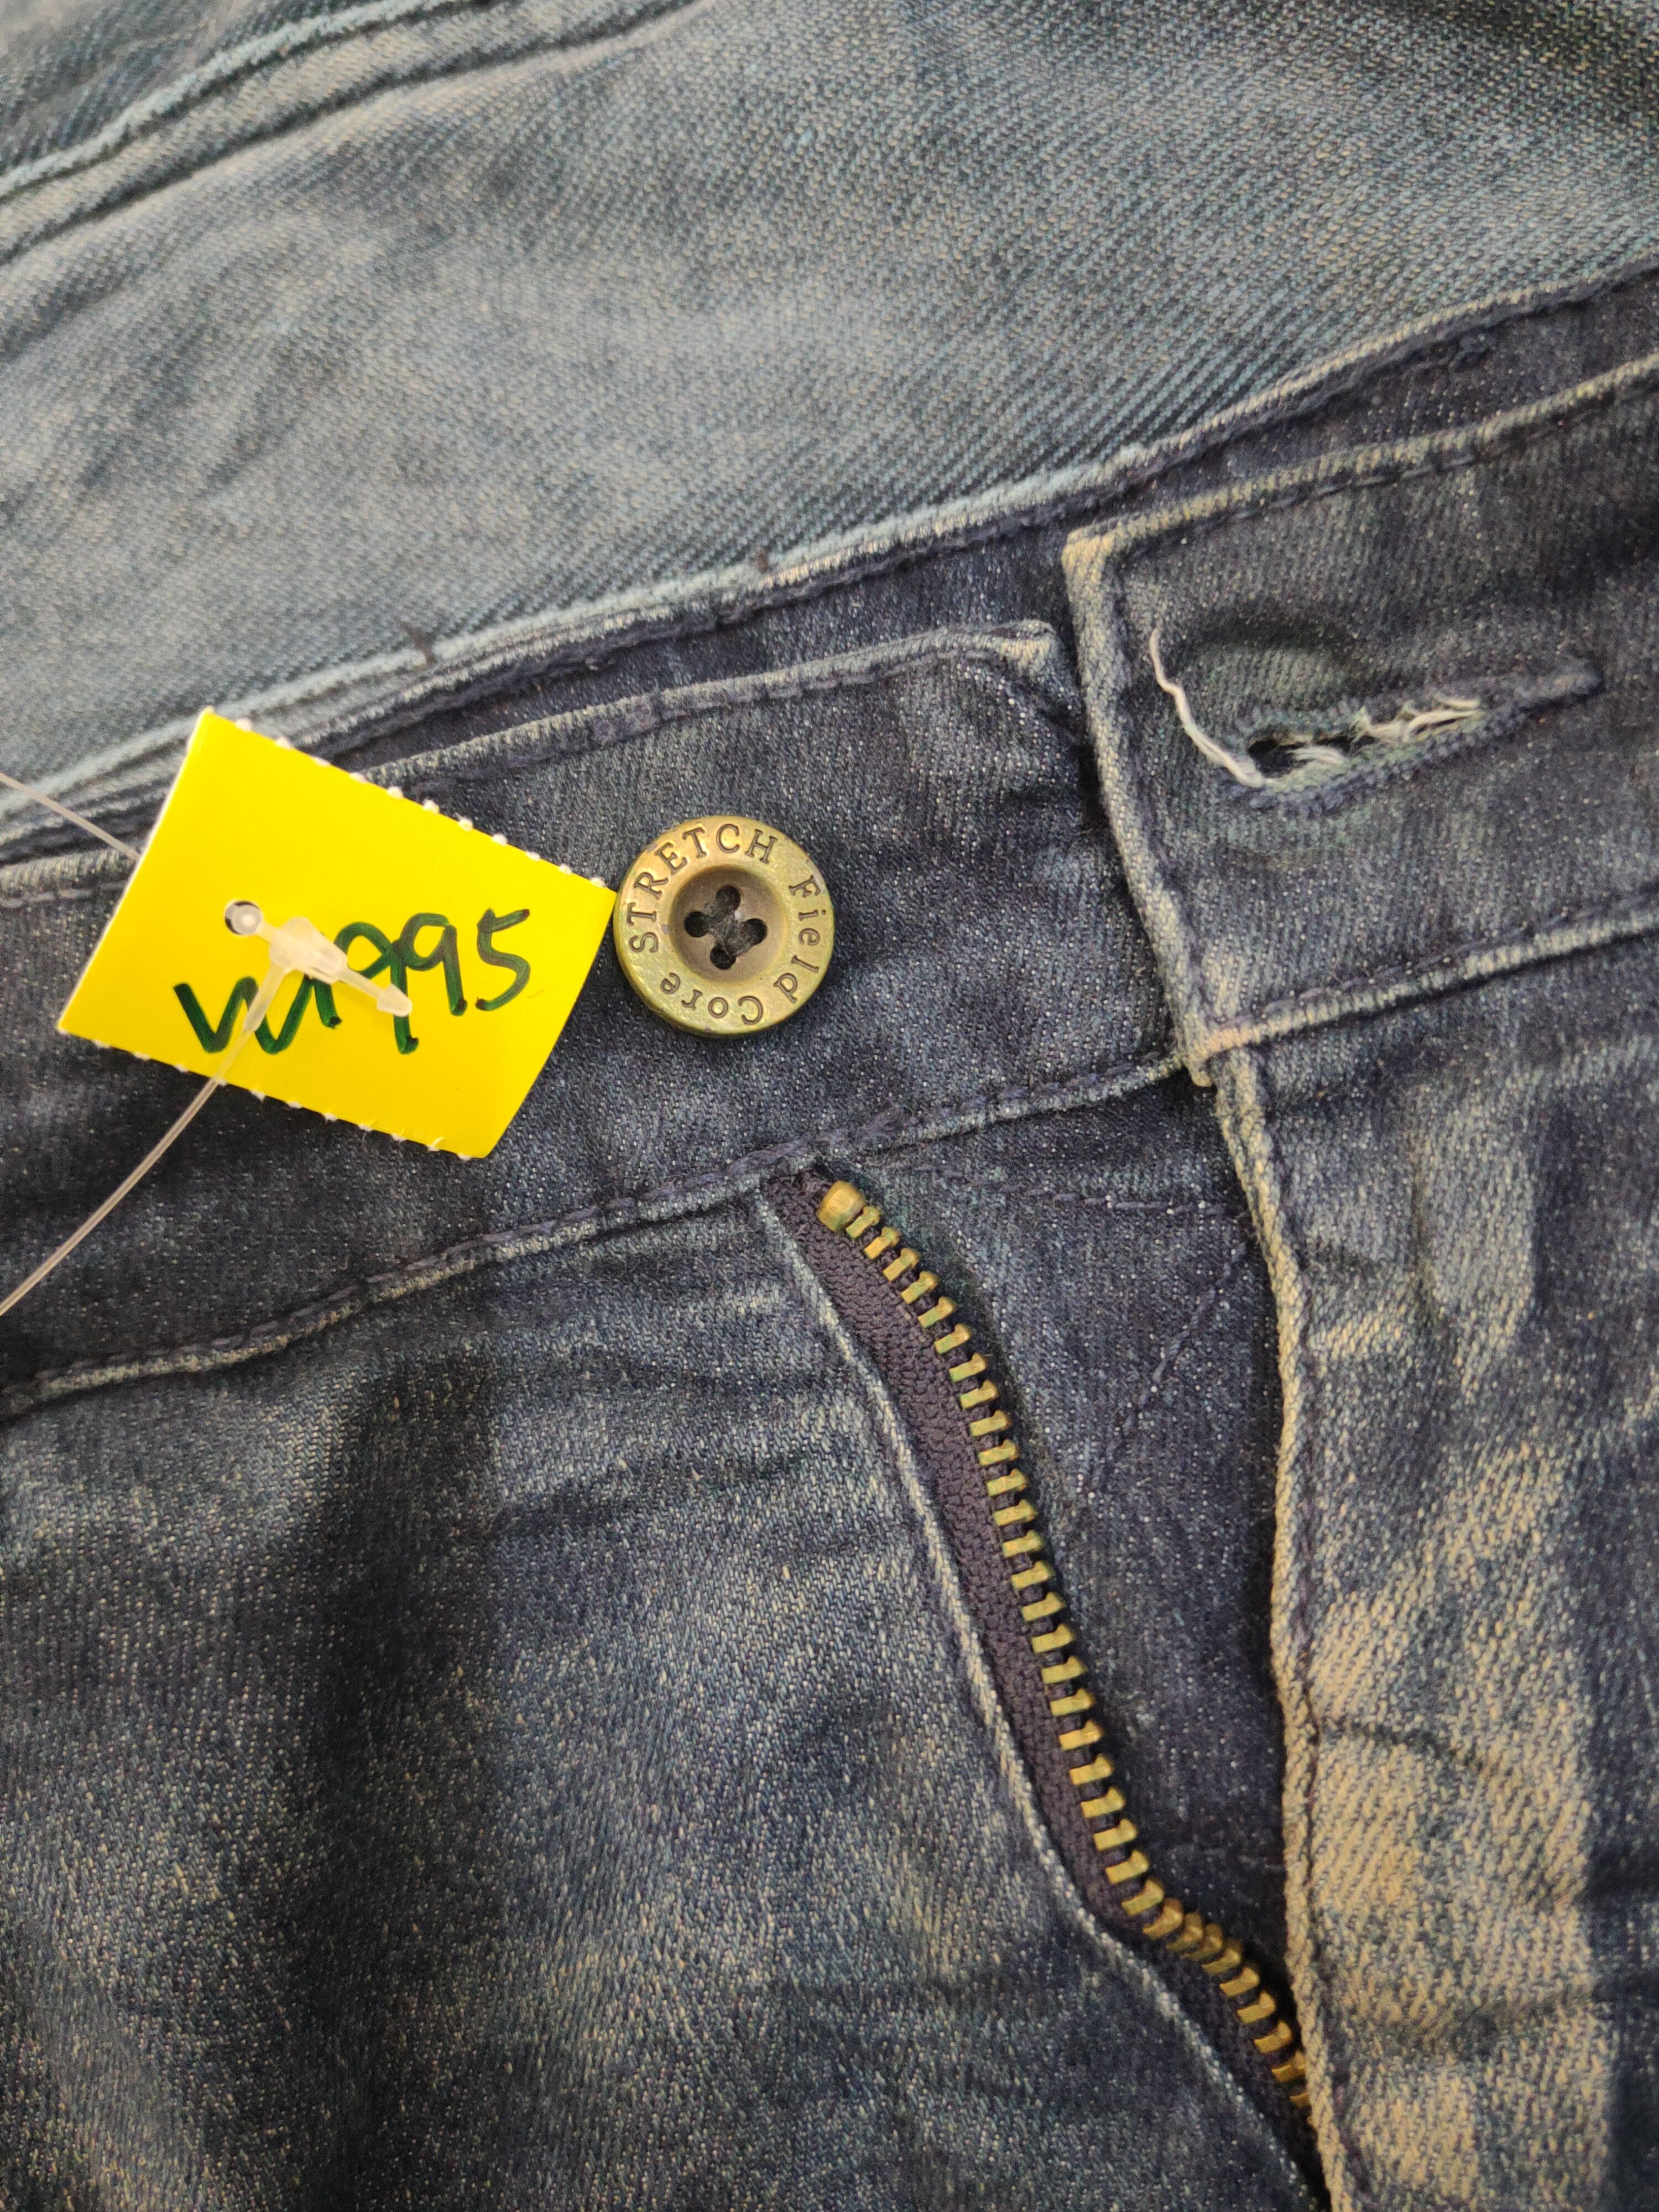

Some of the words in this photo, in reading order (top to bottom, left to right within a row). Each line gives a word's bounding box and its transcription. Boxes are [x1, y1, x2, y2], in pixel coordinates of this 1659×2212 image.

[626, 823, 778, 953] STRETCH
[773, 875, 827, 1004] Field
[660, 972, 764, 1026] Core
